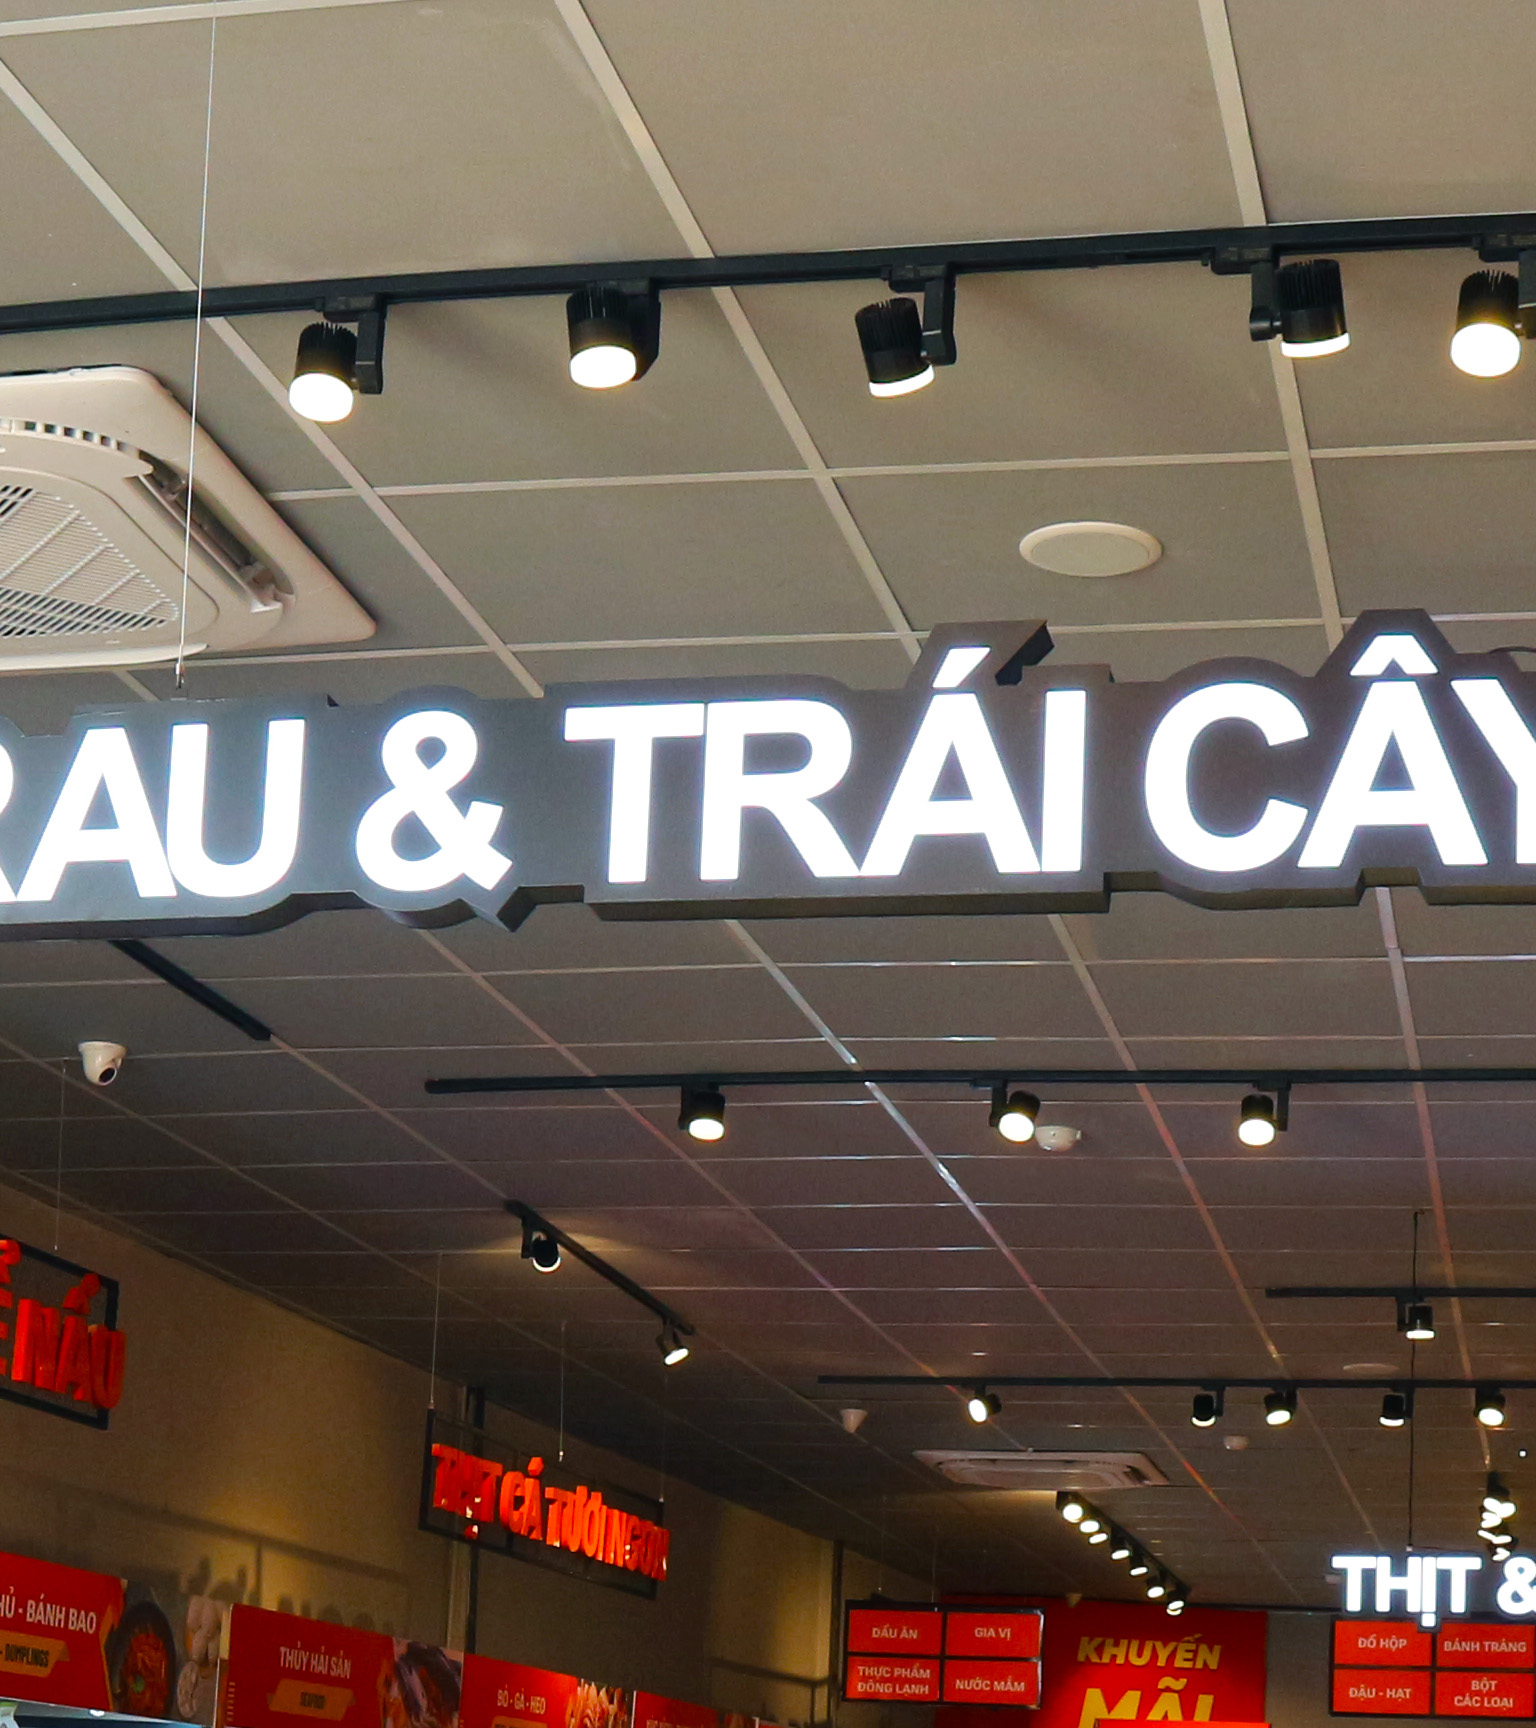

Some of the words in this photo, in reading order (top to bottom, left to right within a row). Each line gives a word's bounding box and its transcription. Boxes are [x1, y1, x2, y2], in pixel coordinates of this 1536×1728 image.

[355, 710, 515, 892] &
[563, 647, 1086, 883] TRÁI
[499, 1457, 544, 1540] CÁ
[1331, 1555, 1482, 1627] THỊT
[26, 1593, 66, 1629] BÁNH
[68, 1608, 97, 1634] BAO
[974, 1626, 997, 1639] GIA
[998, 1626, 1012, 1641] VỊ
[1379, 1634, 1408, 1651] HỘP
[1076, 1632, 1222, 1670] KHUYẾN
[1444, 1637, 1480, 1652] BÁNH
[1483, 1638, 1527, 1653] TRÁNG
[280, 1640, 309, 1671] THỦY
[330, 1650, 352, 1679] SẢN
[857, 1665, 891, 1682] THỰC
[893, 1663, 931, 1680] PHẨM
[857, 1678, 893, 1695] ĐÔNG
[895, 1682, 929, 1698] LẠNH
[1349, 1683, 1376, 1701] ĐẬU
[1386, 1687, 1412, 1701] HẠT
[1471, 1677, 1497, 1693] BỘT
[530, 1695, 546, 1715] HEO
[1454, 1693, 1481, 1708] CÁC
[1484, 1696, 1513, 1710] LOẠI
